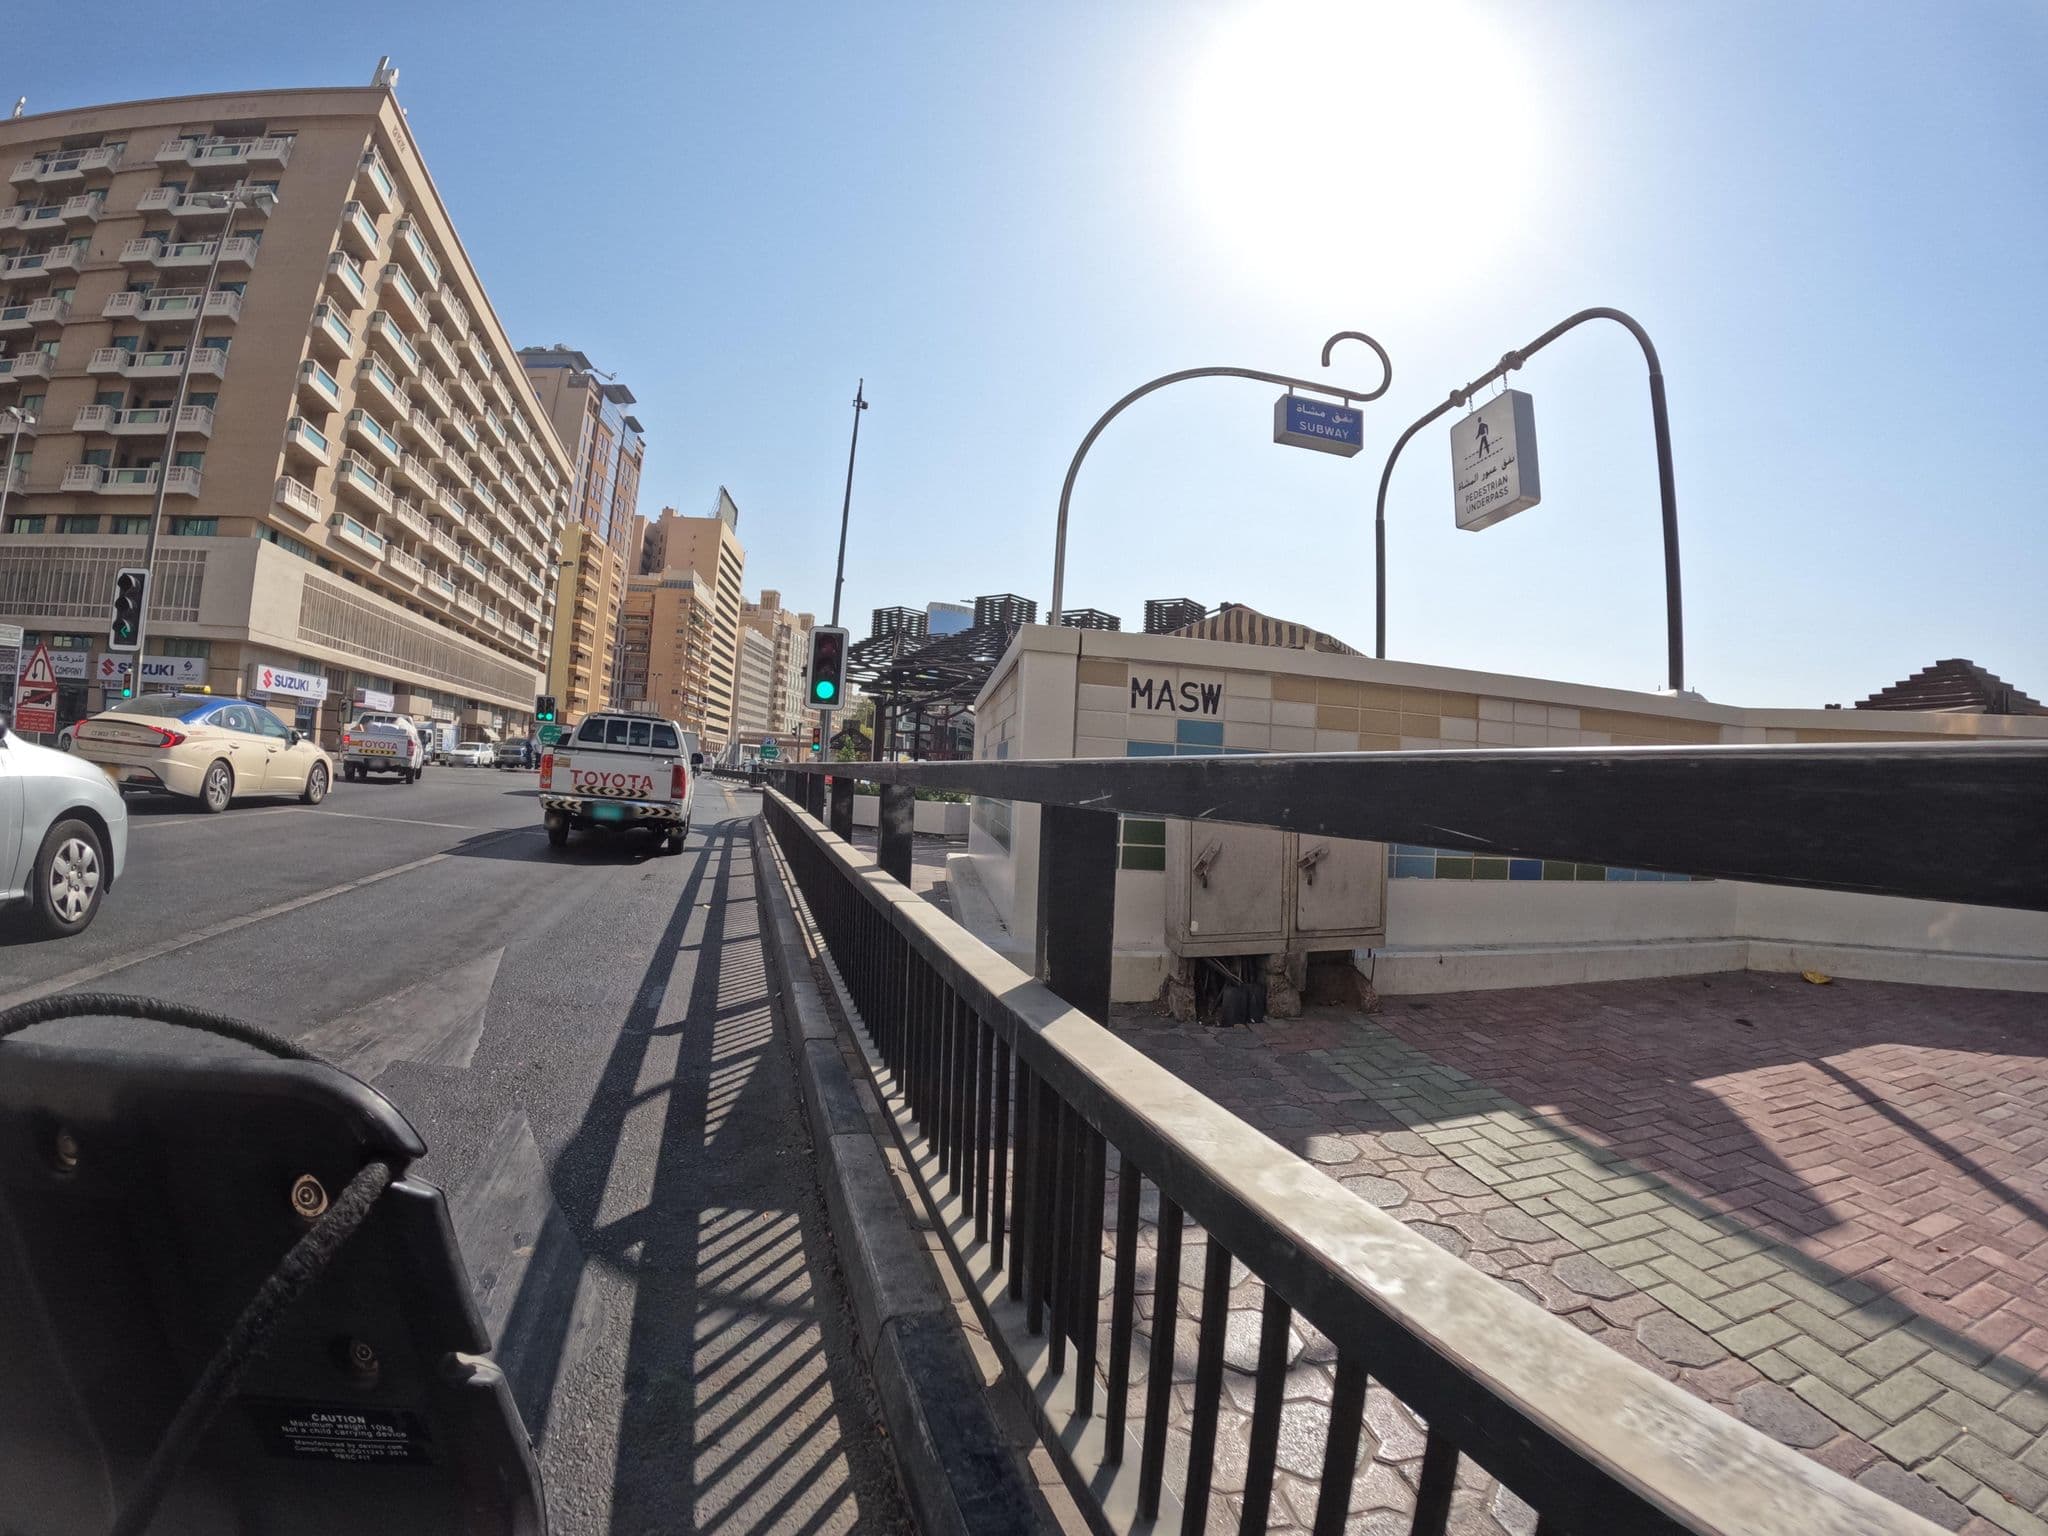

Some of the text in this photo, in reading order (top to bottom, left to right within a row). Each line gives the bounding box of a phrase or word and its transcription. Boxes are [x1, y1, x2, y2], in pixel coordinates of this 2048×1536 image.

[1299, 421, 1350, 440] SUBWAY
[1465, 475, 1508, 504] PEDESTRIAN
[1466, 486, 1509, 514] UNDERPASS
[54, 665, 83, 676] COMPANY
[117, 662, 175, 677] SZUKI
[274, 674, 309, 692] SUZUKI
[1130, 677, 1222, 715] MASW
[359, 740, 398, 750] TOYOTA
[570, 770, 654, 790] TOYOTA
[289, 1419, 394, 1433] Maximum weight 10kg
[311, 1413, 366, 1424] CAUTION
[281, 1425, 298, 1433] Not
[309, 1427, 332, 1435] child
[334, 1429, 373, 1438] carrying
